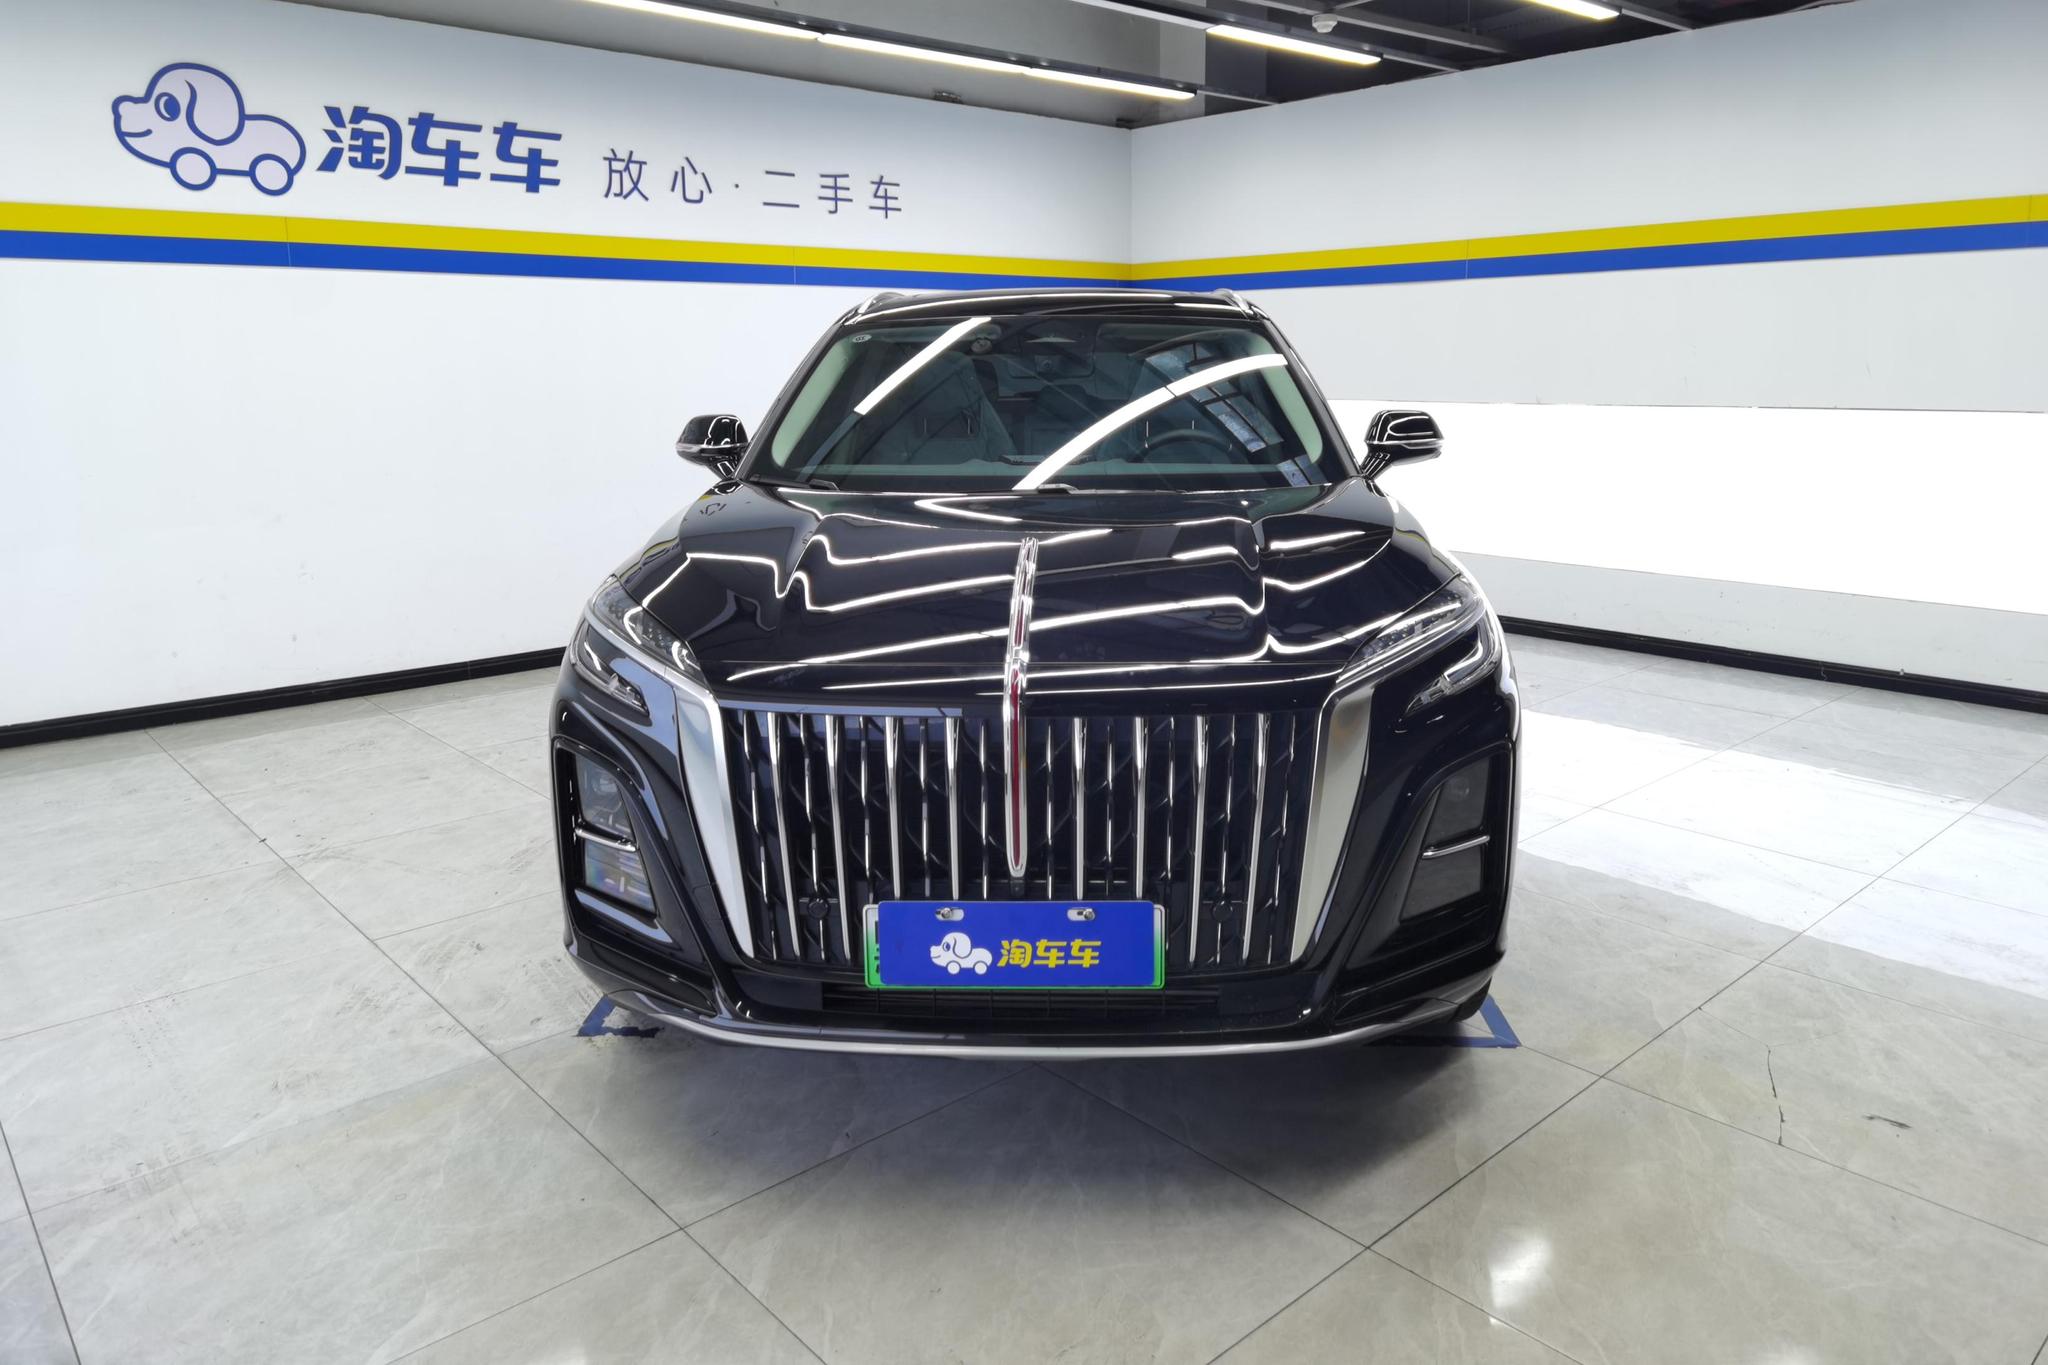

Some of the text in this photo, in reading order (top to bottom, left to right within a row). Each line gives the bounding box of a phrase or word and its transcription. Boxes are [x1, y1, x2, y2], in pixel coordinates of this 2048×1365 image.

[316, 105, 562, 193] 淘车车
[997, 939, 1102, 968] 淘车车
